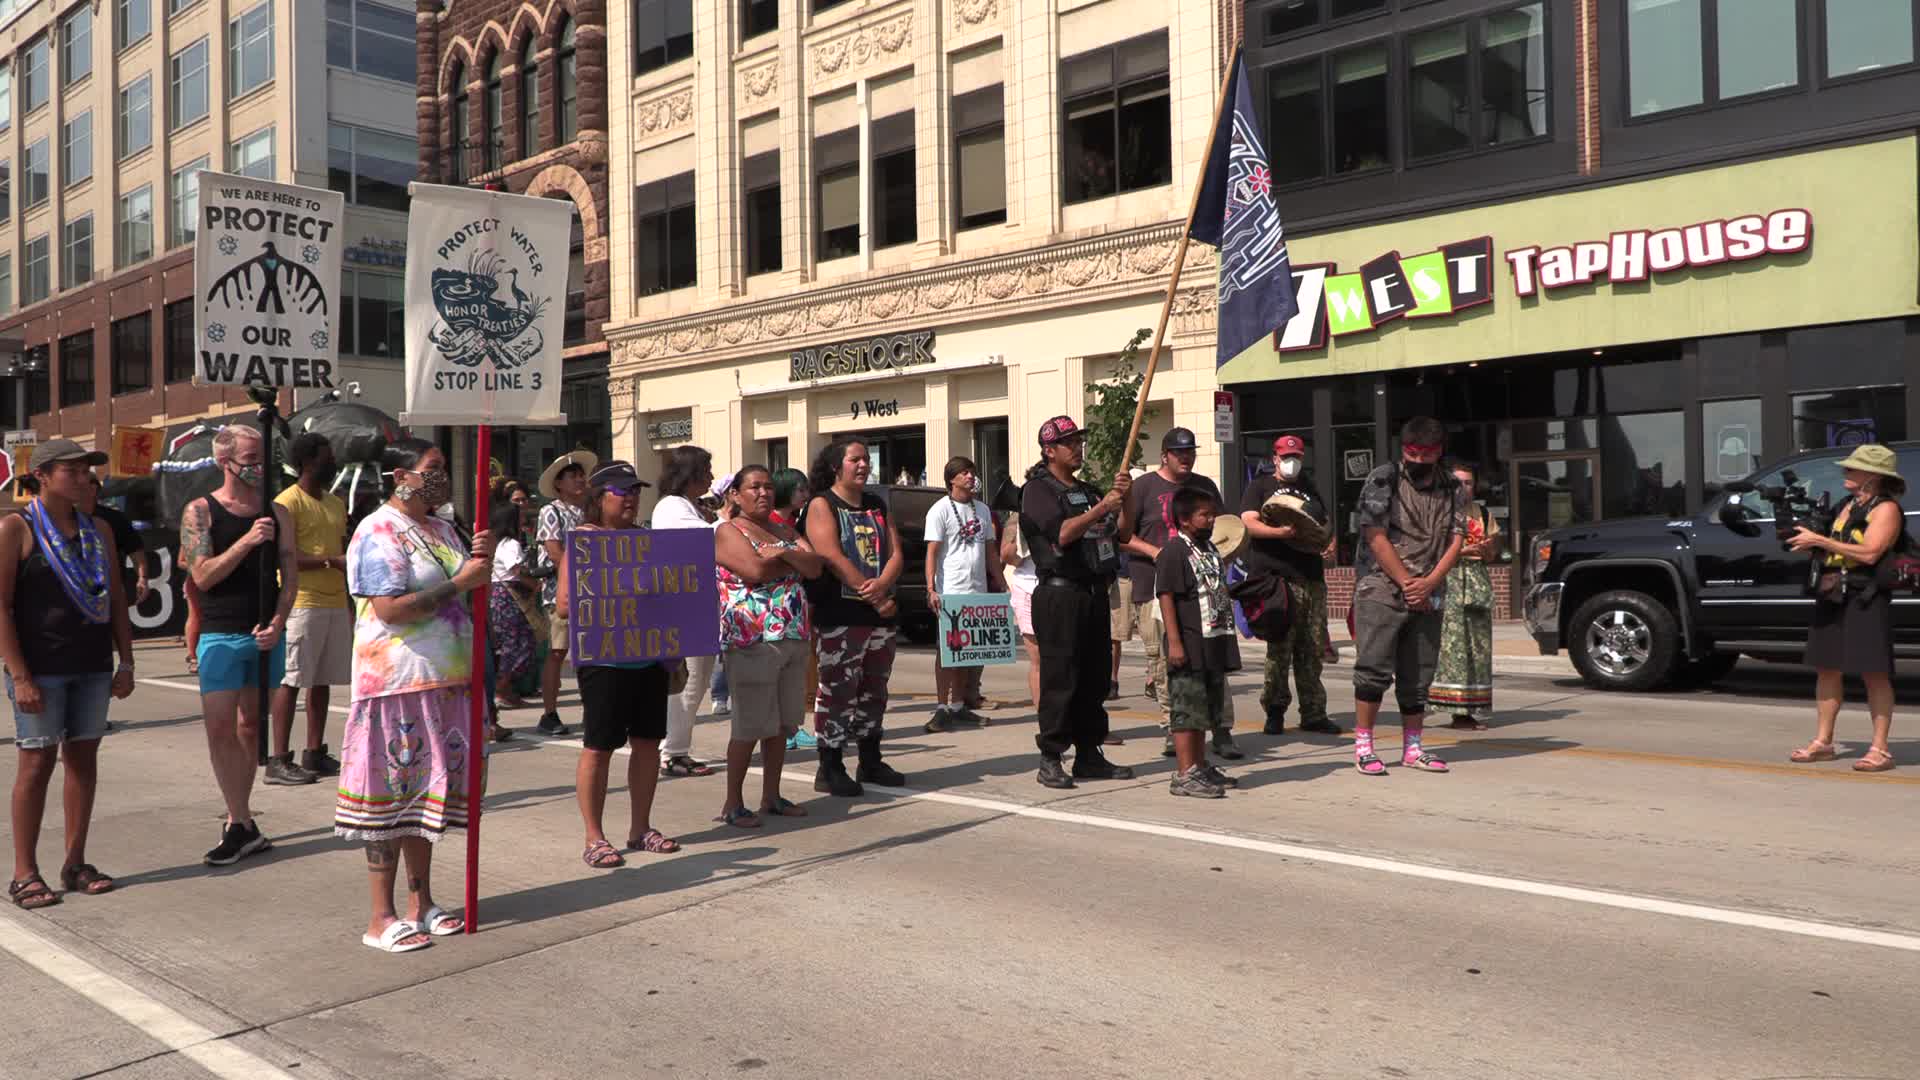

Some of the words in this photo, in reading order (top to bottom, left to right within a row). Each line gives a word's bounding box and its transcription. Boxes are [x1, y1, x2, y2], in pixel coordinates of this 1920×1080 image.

[221, 188, 240, 199] WE
[245, 190, 269, 202] ARE
[273, 192, 302, 207] HERE
[305, 199, 321, 212] TO
[205, 206, 333, 242] PROTECT
[438, 218, 501, 260] PROTECT
[510, 225, 543, 277] WATER
[444, 304, 488, 318] HONOR
[477, 313, 527, 332] TREATIES
[242, 325, 291, 347] OUR
[790, 330, 936, 382] RAGSTOCK
[200, 350, 334, 388] WATER
[434, 371, 478, 391] STOP
[485, 371, 523, 391] LINE
[531, 372, 542, 391] 3
[850, 402, 860, 420] 9
[864, 399, 899, 418] West
[575, 535, 650, 564] STOP
[576, 564, 699, 597] KILLING
[578, 597, 639, 628] OUR
[962, 605, 1008, 618] PROTECT
[962, 618, 980, 628] OUR
[983, 617, 1009, 627] WATER
[576, 627, 681, 661] LANDS
[971, 629, 1000, 646] LINE
[1002, 628, 1011, 645] 3
